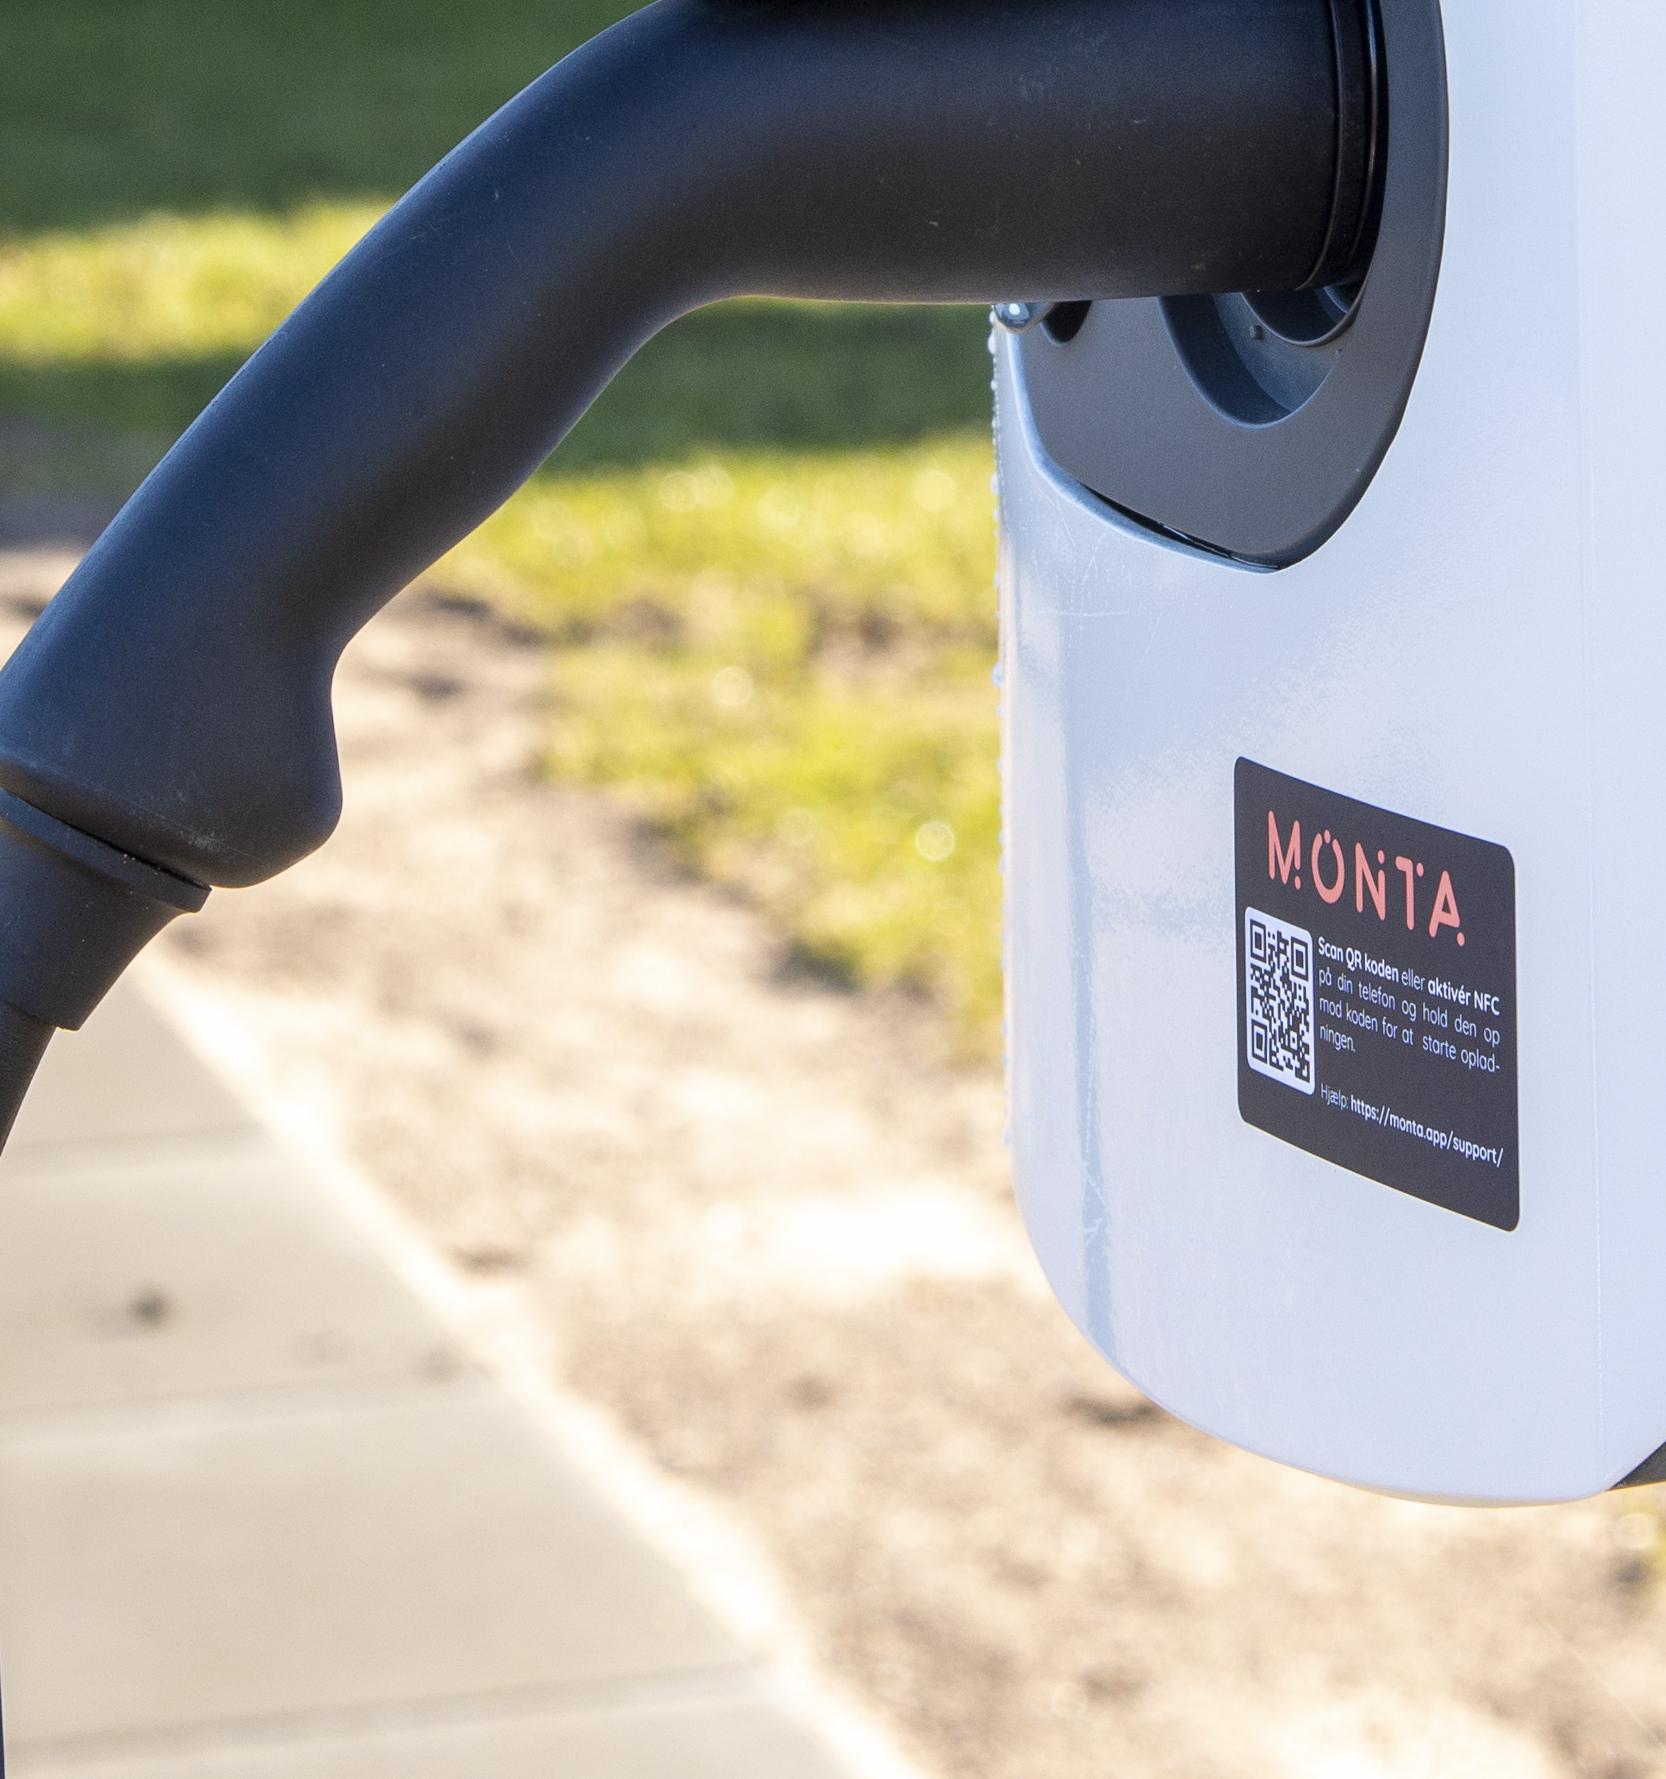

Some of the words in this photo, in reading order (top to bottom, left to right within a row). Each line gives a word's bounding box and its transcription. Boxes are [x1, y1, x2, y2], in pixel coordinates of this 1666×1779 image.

[1267, 809, 1466, 947] MONTA
[1317, 935, 1344, 963] Scan
[1345, 946, 1363, 971] QR
[1364, 952, 1400, 984] koden
[1401, 968, 1426, 991] eller
[1427, 977, 1471, 1007] aktivér
[1473, 990, 1501, 1016] NFC
[1318, 966, 1333, 987] på
[1337, 972, 1354, 995] din
[1357, 980, 1396, 1010] telefon
[1401, 999, 1417, 1022] og
[1422, 1001, 1448, 1029] hold
[1454, 1014, 1478, 1038] den
[1483, 1026, 1501, 1049] op
[1319, 996, 1343, 1019] mod
[1345, 1002, 1379, 1033] koden
[1381, 1016, 1399, 1040] for
[1401, 1027, 1414, 1046] at
[1421, 1034, 1457, 1061] starte
[1460, 1048, 1501, 1073] oplad-
[1319, 1024, 1356, 1053] ningen.
[1320, 1082, 1350, 1111] Hjælp:
[1350, 1094, 1504, 1169] https://monta.app/support/
